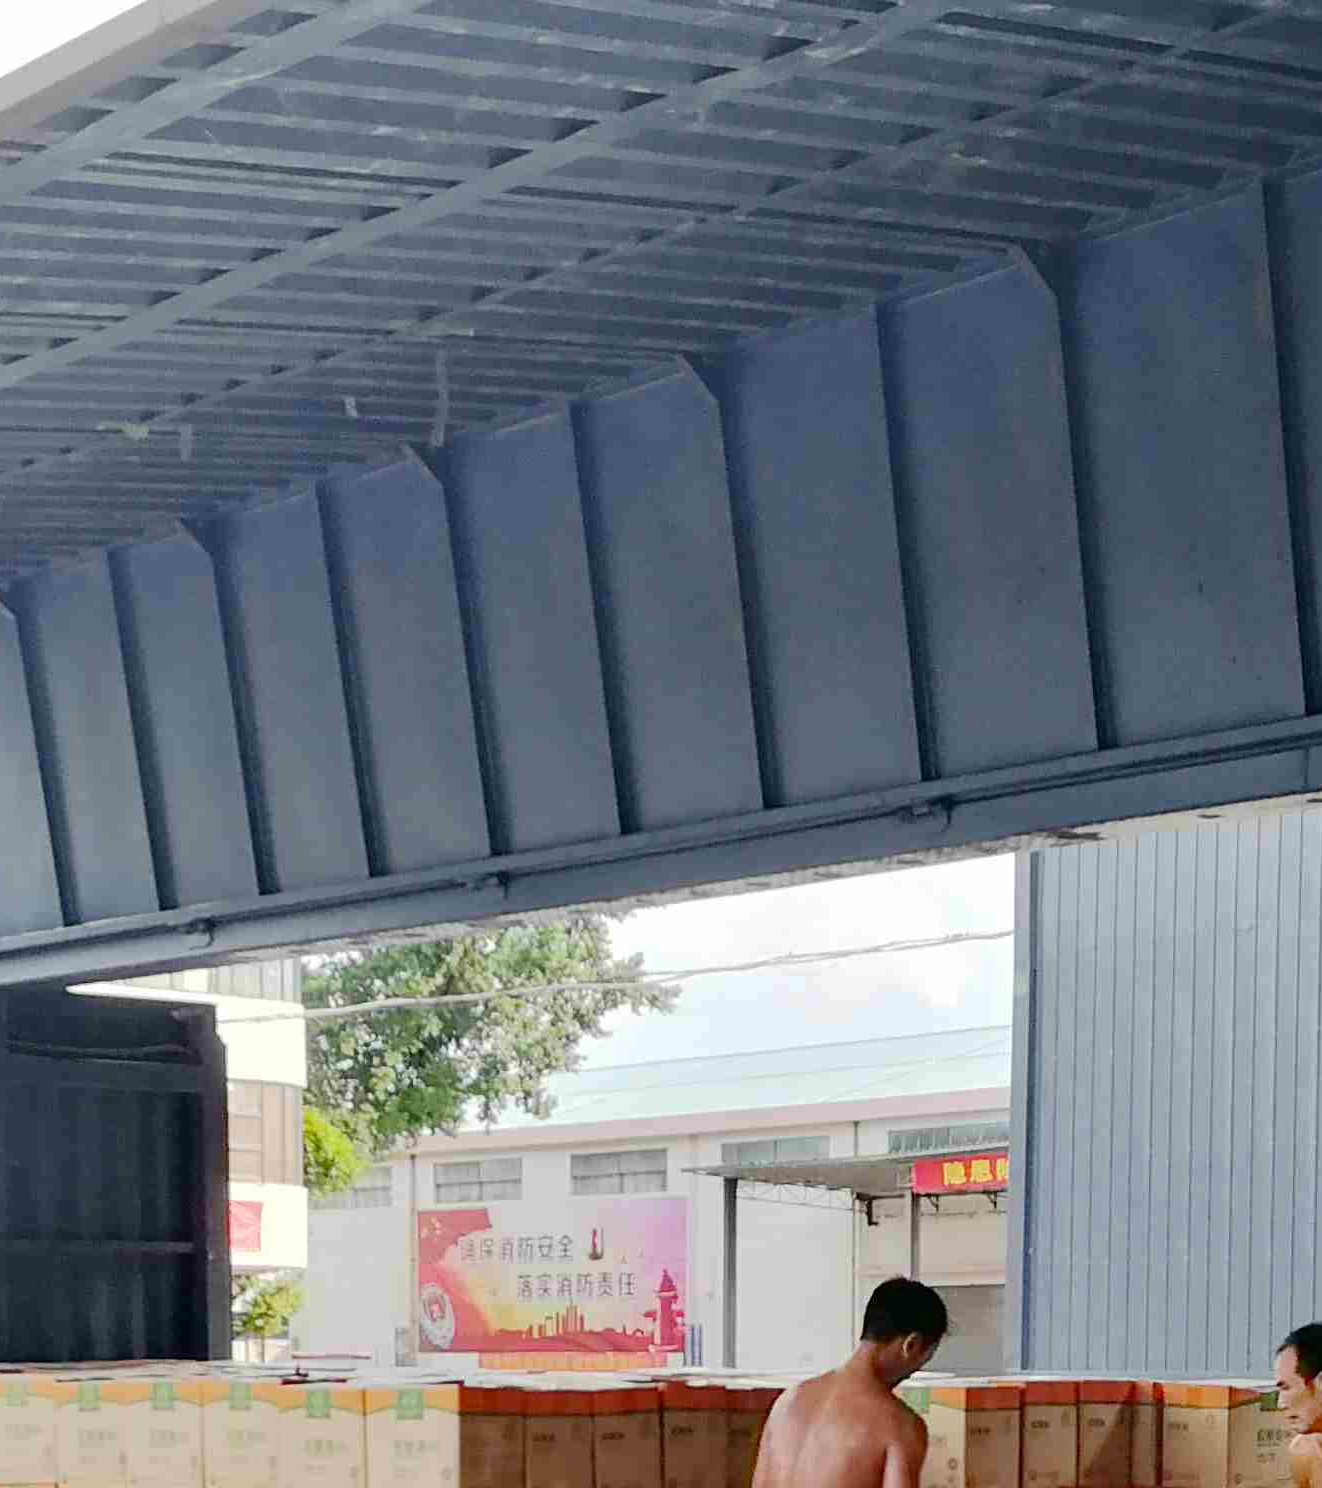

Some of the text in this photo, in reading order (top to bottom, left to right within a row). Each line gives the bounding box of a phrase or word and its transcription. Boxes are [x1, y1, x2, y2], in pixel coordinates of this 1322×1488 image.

[517, 1272, 637, 1297] 落实消防责任
